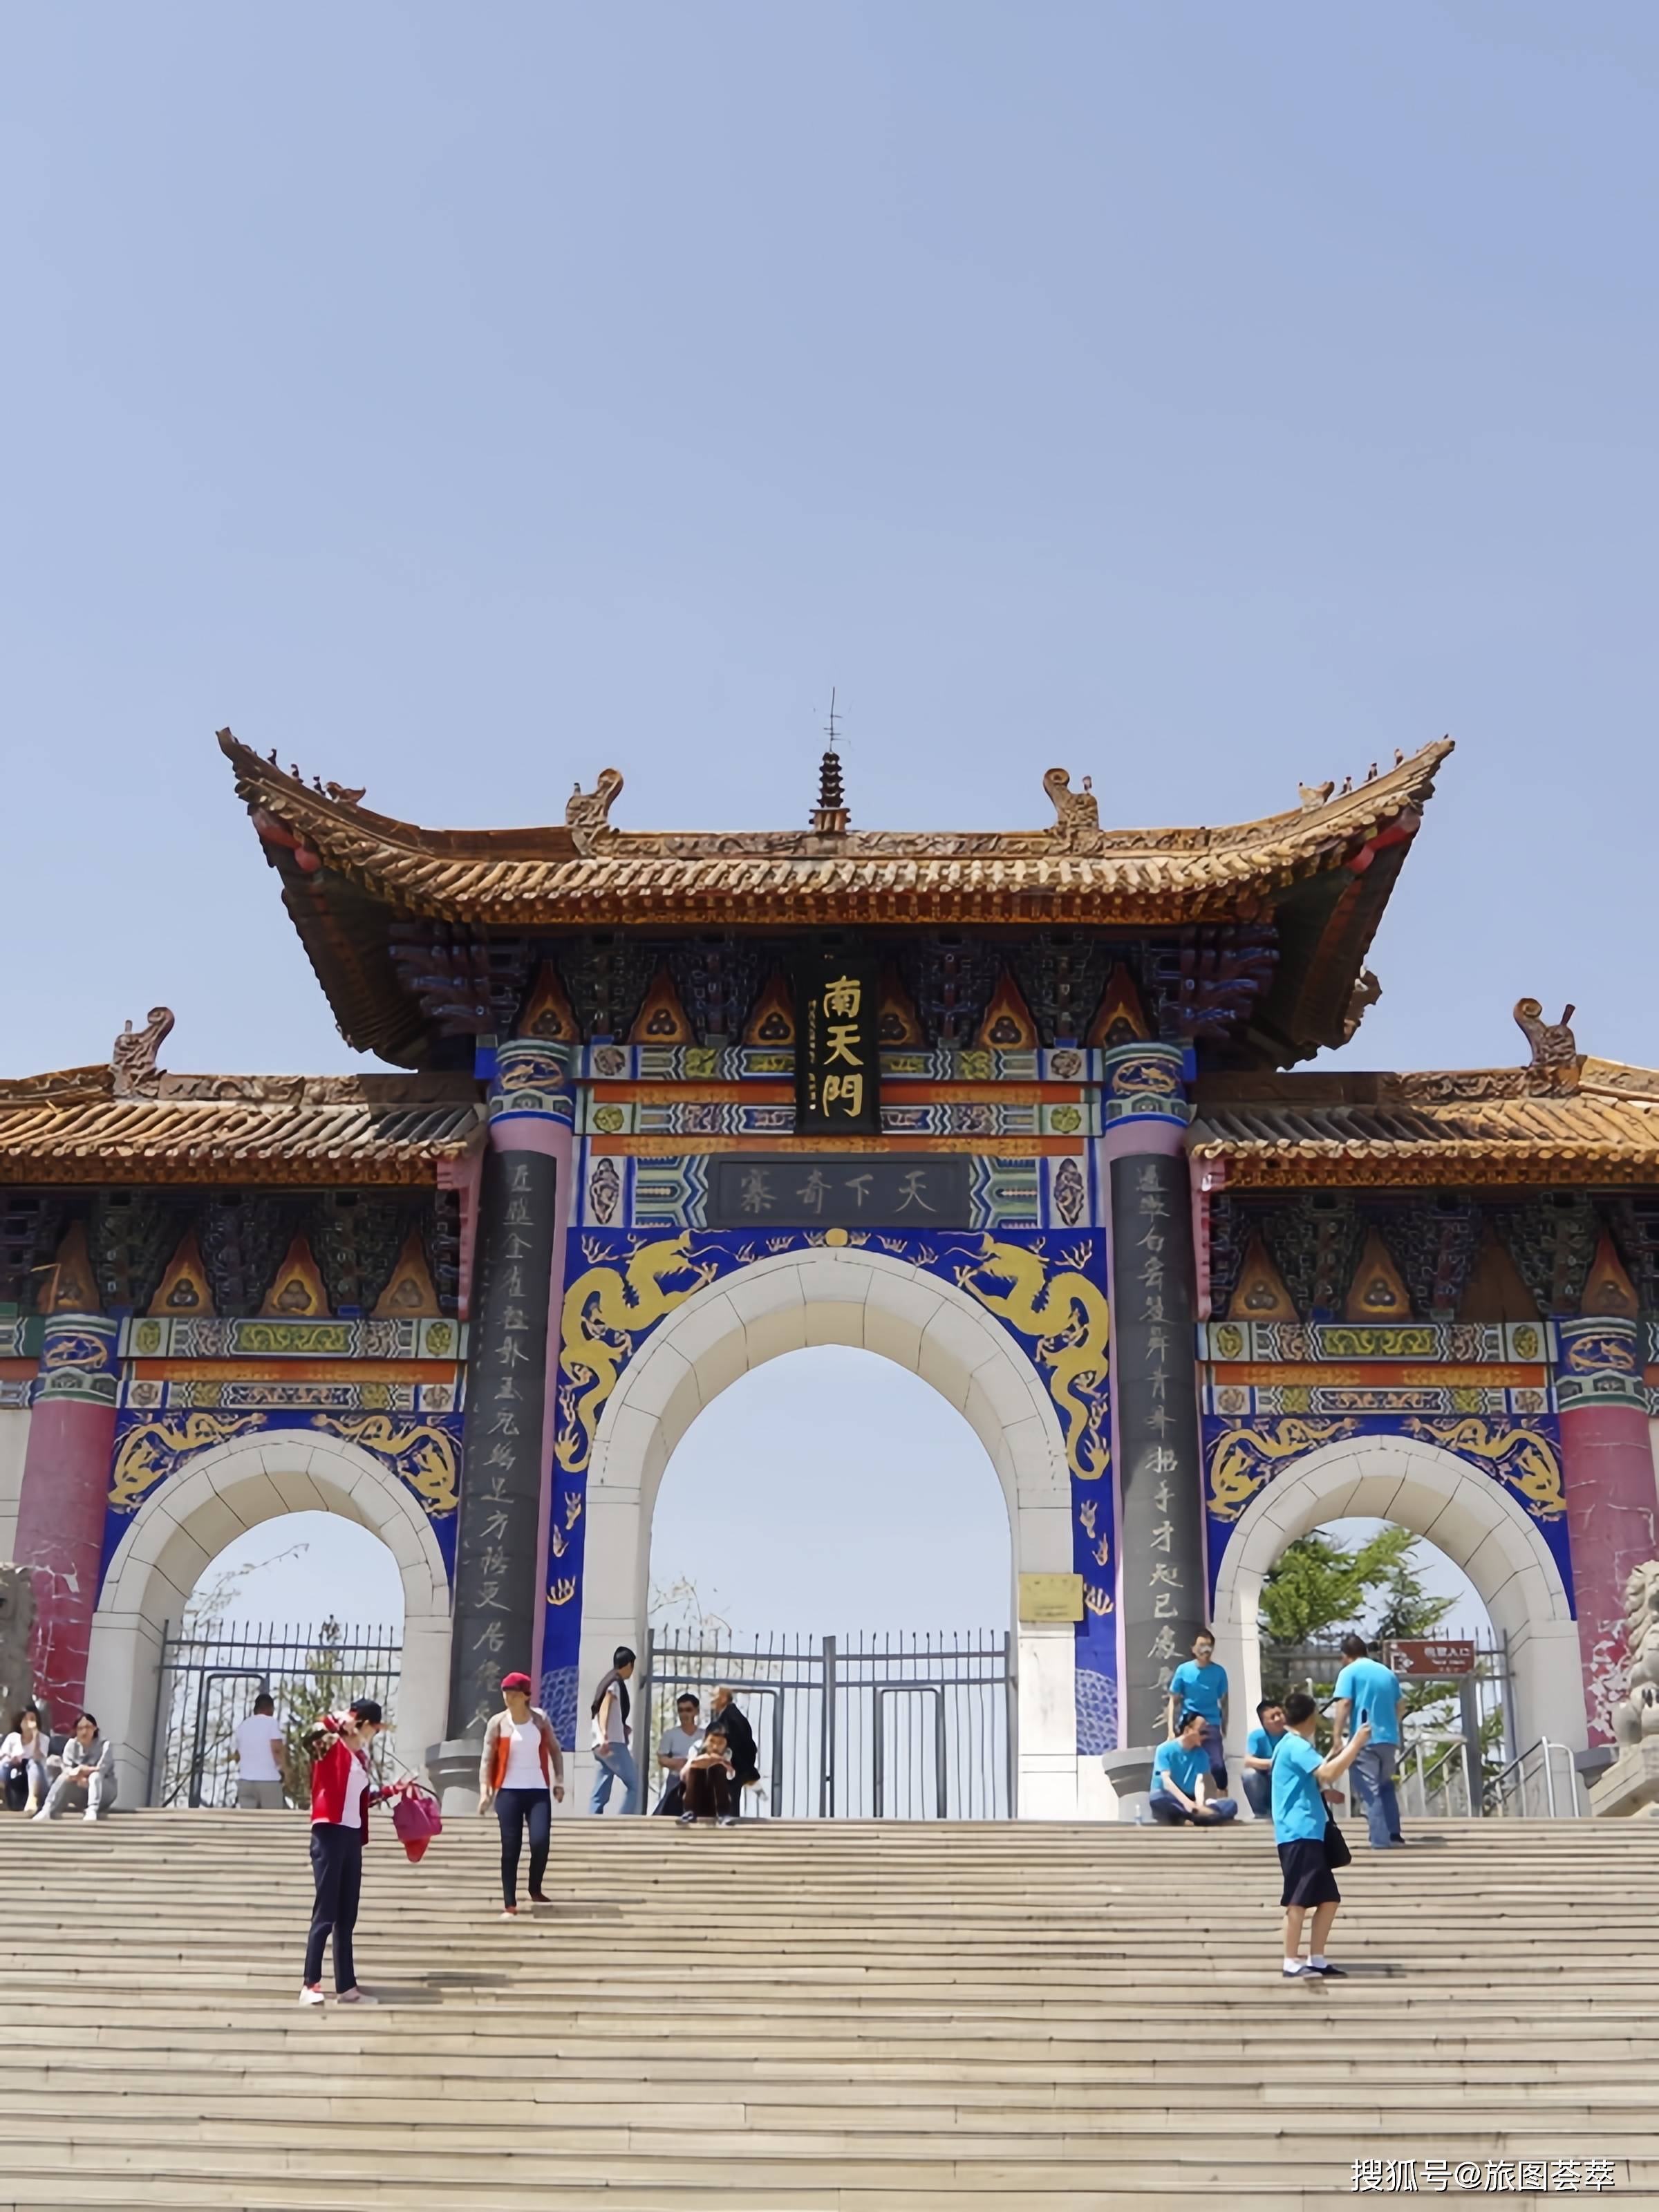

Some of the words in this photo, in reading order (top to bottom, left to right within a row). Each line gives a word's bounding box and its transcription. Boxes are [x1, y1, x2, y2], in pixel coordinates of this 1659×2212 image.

[823, 975, 864, 1117] 南天門
[738, 1168, 937, 1214] 天下奇寨
